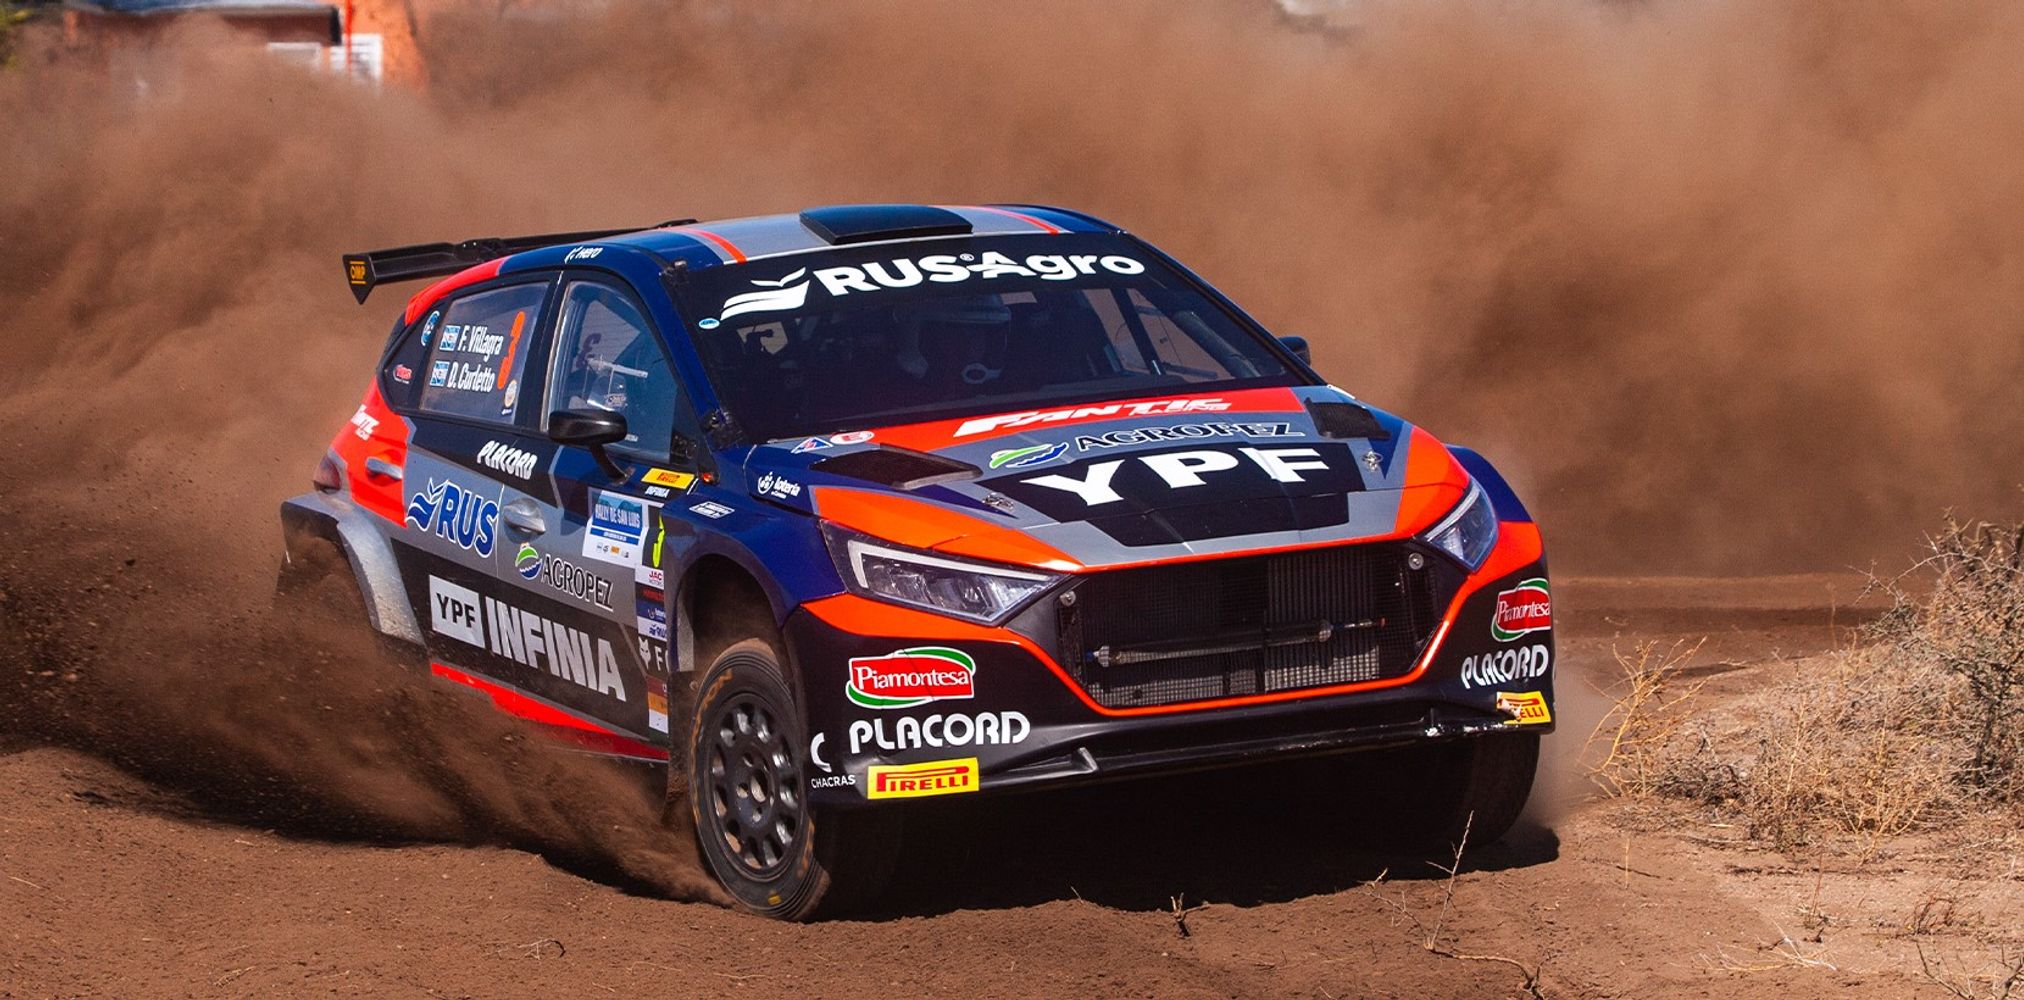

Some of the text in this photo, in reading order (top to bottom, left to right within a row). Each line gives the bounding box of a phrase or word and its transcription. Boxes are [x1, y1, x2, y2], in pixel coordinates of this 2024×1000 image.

[457, 325, 470, 352] F.
[467, 326, 504, 362] Villagra
[446, 361, 459, 388] D.
[457, 362, 496, 393] Curletto
[952, 397, 1224, 438] FANTIC
[1075, 421, 1306, 453] AGROPEZ
[477, 441, 538, 480] PLACORD
[1018, 446, 1330, 507] YPF
[436, 481, 500, 559] RUS
[541, 554, 614, 612] AGROPEZ
[436, 593, 476, 629] YPF
[485, 596, 627, 702] INFINIA
[1461, 644, 1549, 689] PLACORD
[854, 666, 969, 690] Piamontesa
[849, 711, 1031, 754] PLACORD
[811, 775, 856, 789] CHACRAS
[876, 766, 969, 792] PIRELLI
